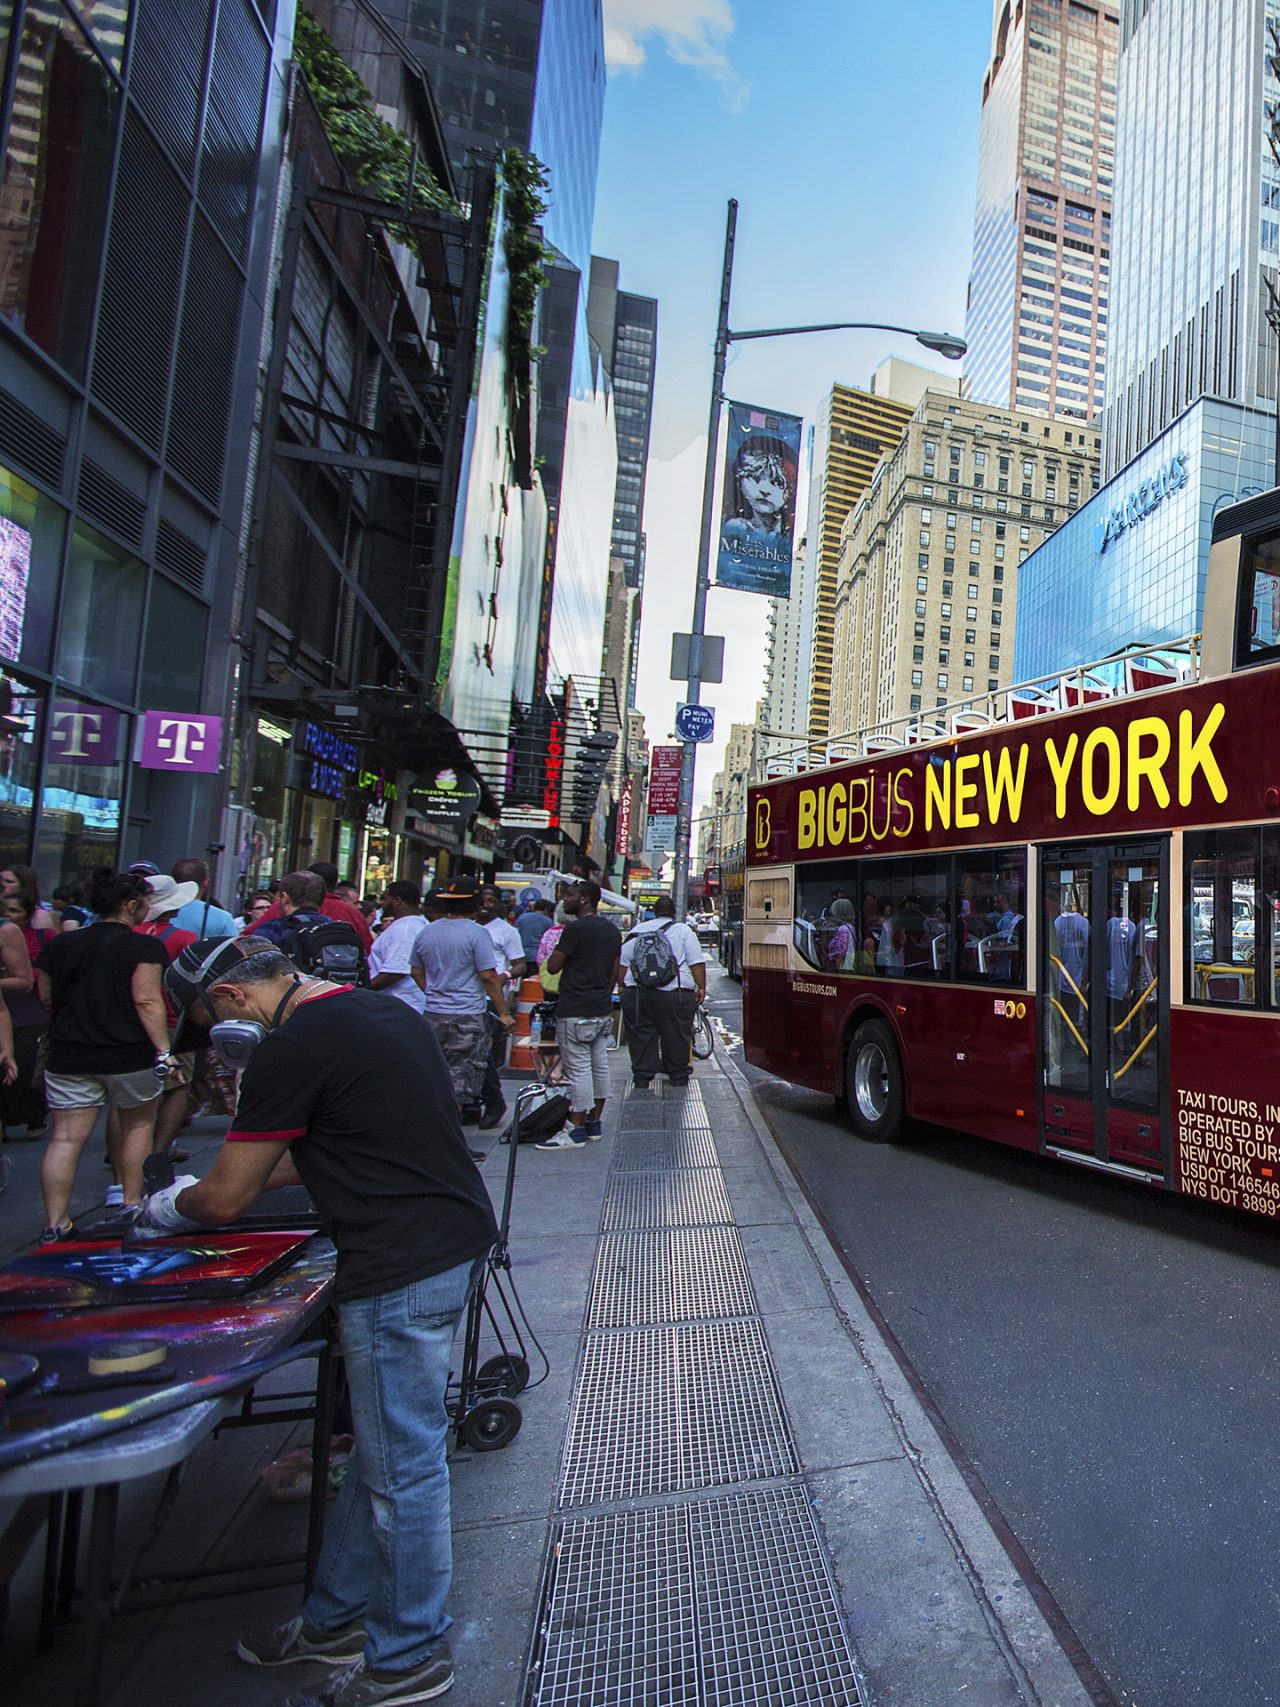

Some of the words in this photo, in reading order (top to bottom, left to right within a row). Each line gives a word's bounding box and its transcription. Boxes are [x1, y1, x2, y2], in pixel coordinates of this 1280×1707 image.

[1107, 451, 1186, 541] BARCLAYS
[682, 709, 691, 720] P
[692, 717, 713, 725] METER
[925, 743, 1029, 832] NEW
[1045, 703, 1228, 820] YORK
[413, 788, 444, 796] FROZEN
[446, 790, 477, 798] YOGURT
[426, 809, 461, 817] WAFFLES
[792, 981, 838, 997] BIGBUSTOURS.COM
[1177, 1089, 1206, 1109] TAXI
[1209, 1094, 1262, 1122] TOURS,
[1179, 1110, 1251, 1138] OPERATED
[1255, 1124, 1274, 1142] BY
[1179, 1126, 1202, 1145] BIG
[1205, 1132, 1233, 1152] BUS
[1180, 1143, 1210, 1164] NEW
[1213, 1151, 1252, 1175] YORK
[1181, 1160, 1226, 1185] USDOT
[1181, 1177, 1207, 1197] NYS
[1211, 1184, 1238, 1206] DOT
